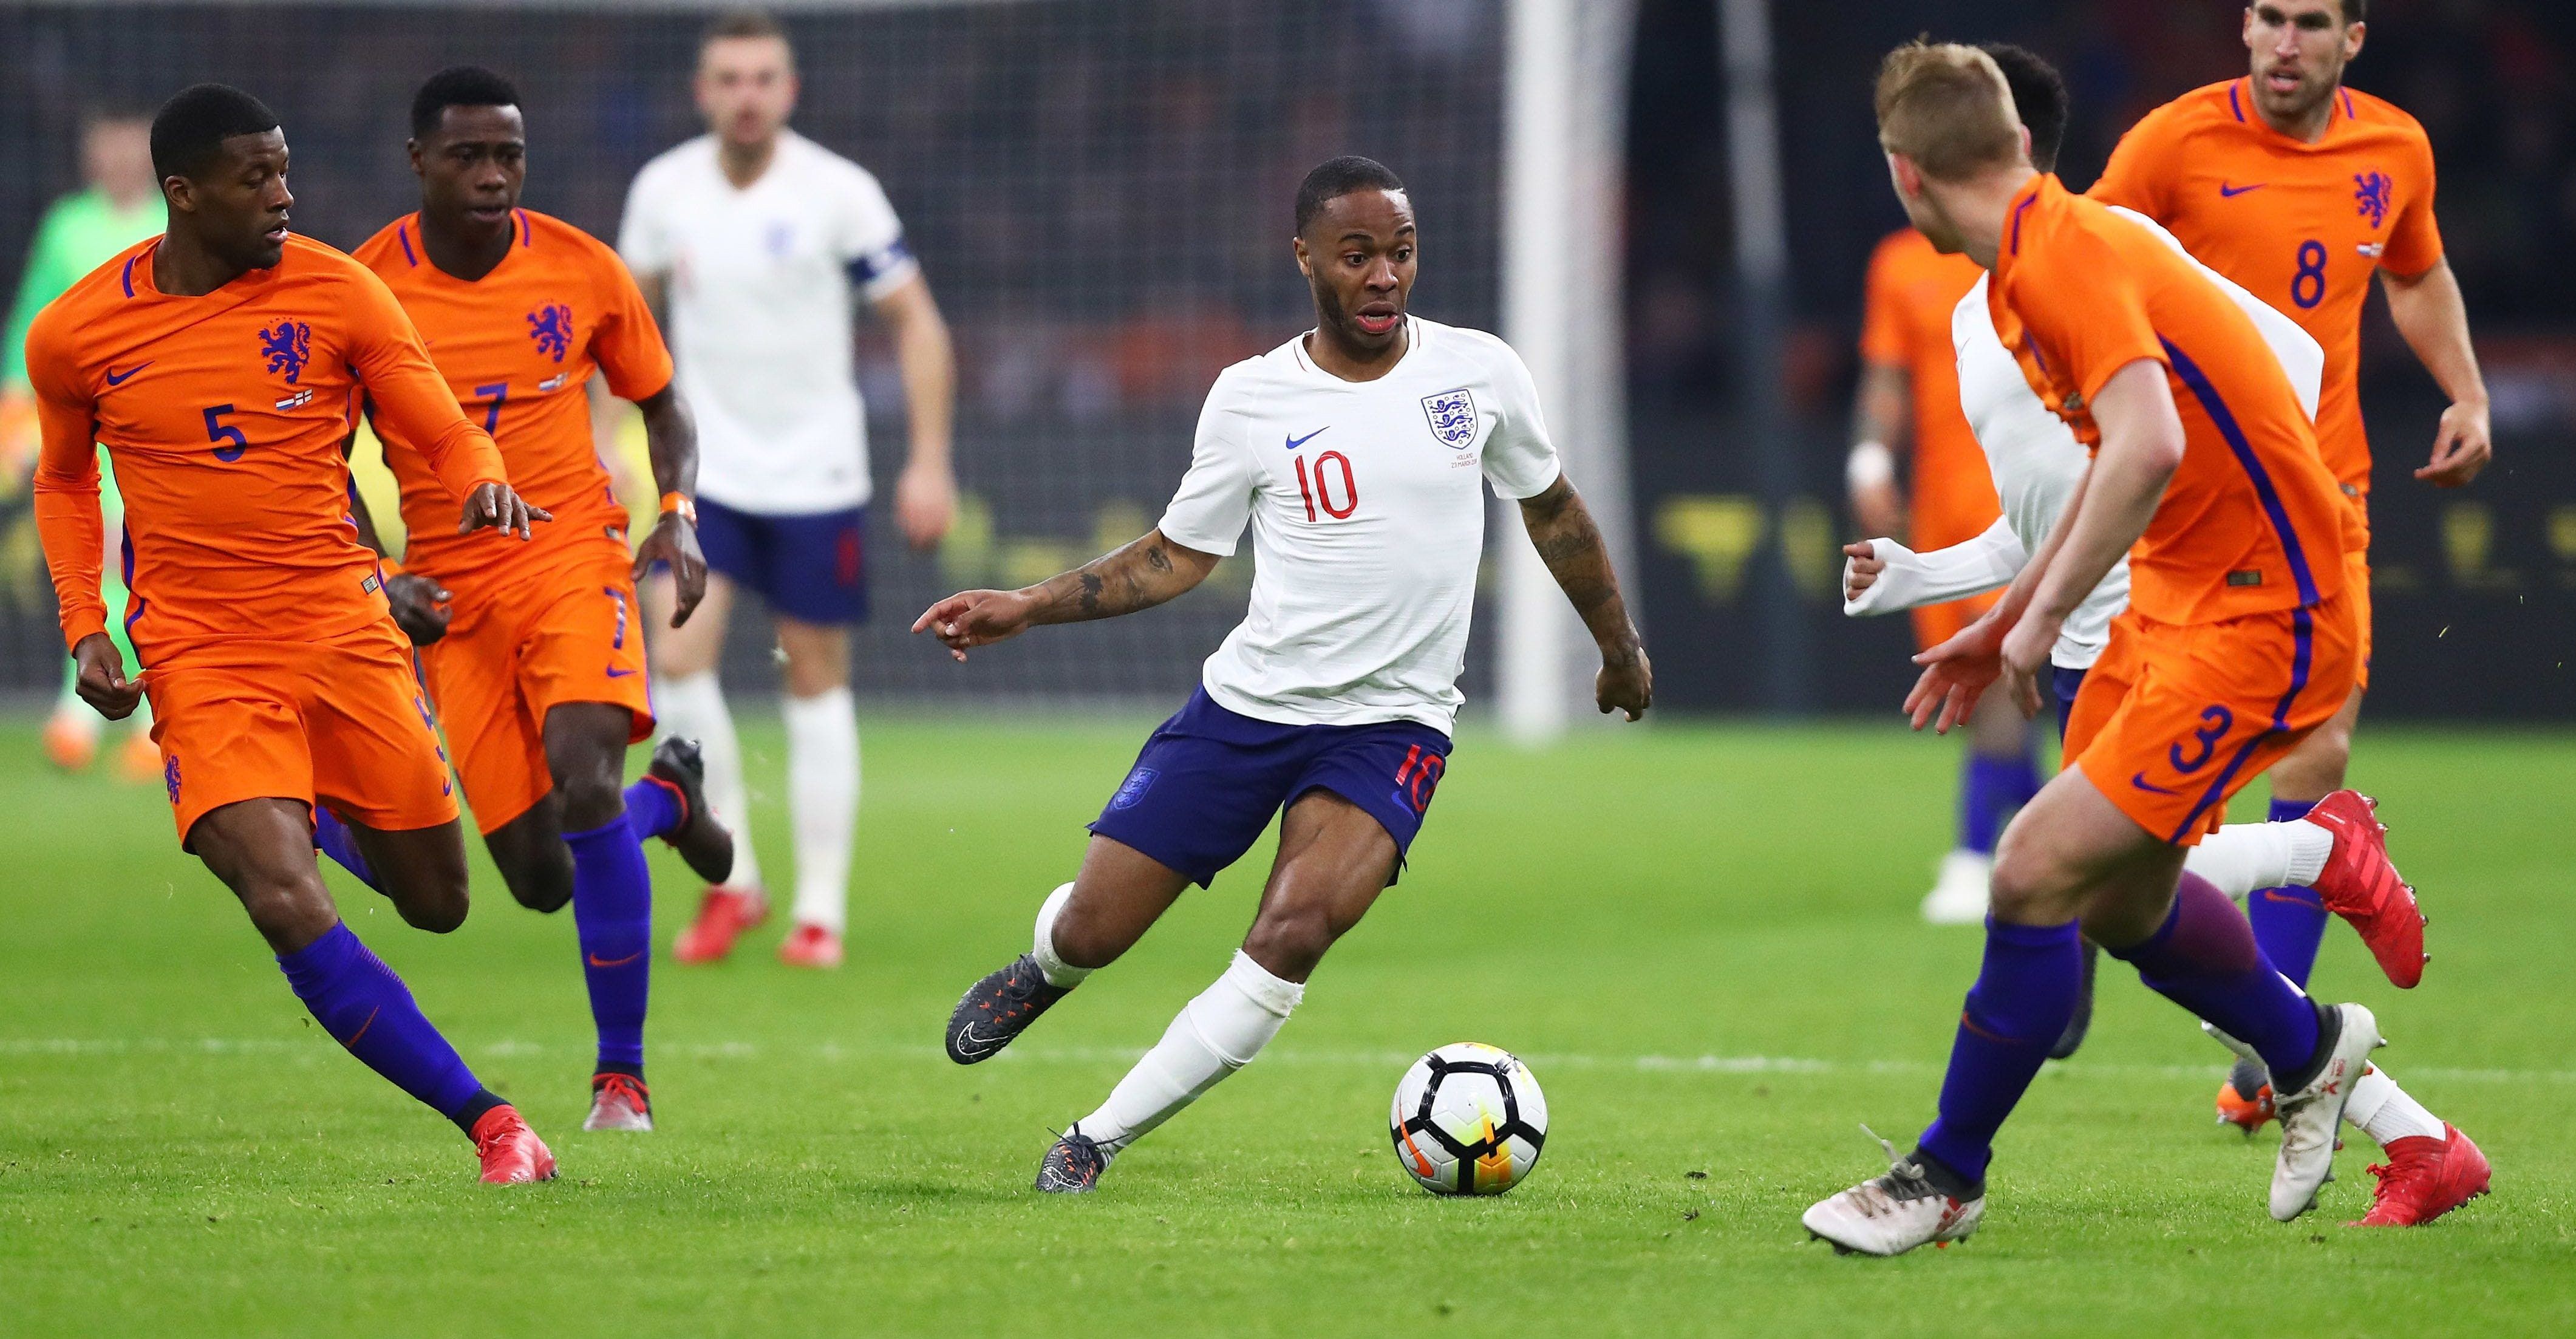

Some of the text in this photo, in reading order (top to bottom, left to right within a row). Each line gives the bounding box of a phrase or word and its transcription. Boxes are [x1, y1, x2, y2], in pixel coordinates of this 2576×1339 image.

[2291, 239, 2326, 308] 8
[203, 403, 248, 462] 5
[475, 383, 508, 435] 7
[1295, 451, 1358, 522] 10
[604, 586, 625, 649] 7
[2170, 704, 2232, 774] 3
[1395, 743, 1444, 813] 10
